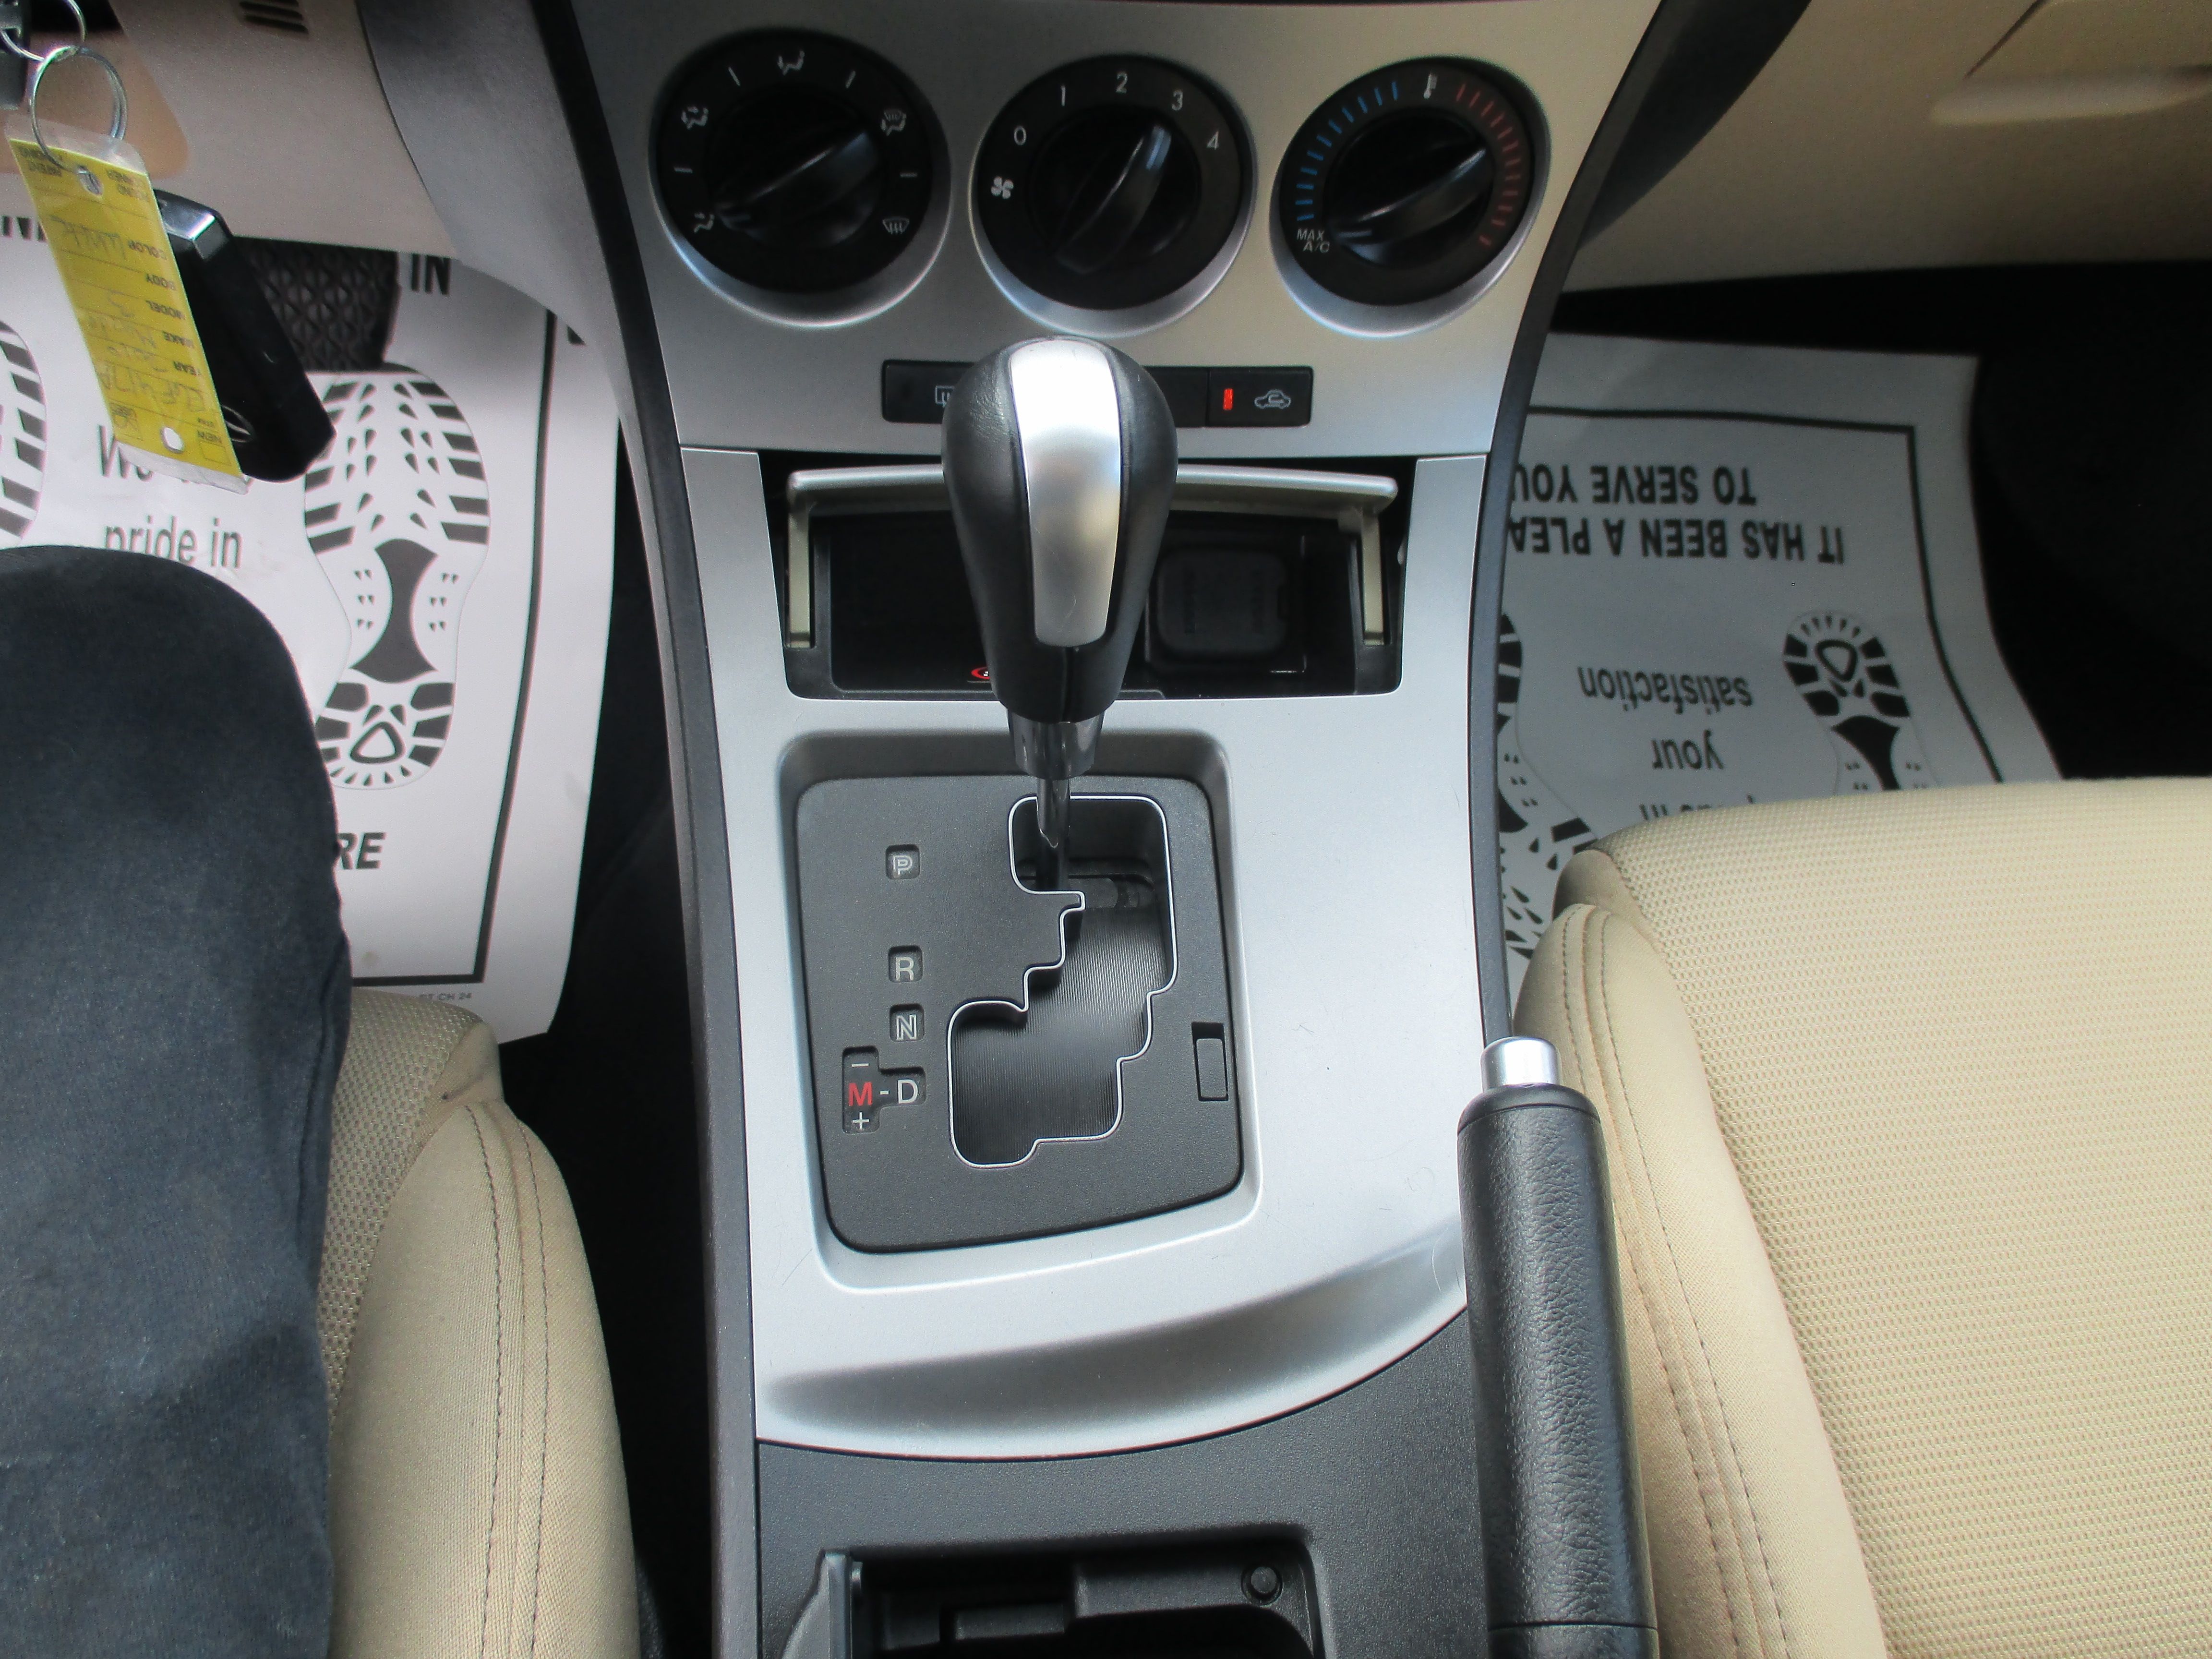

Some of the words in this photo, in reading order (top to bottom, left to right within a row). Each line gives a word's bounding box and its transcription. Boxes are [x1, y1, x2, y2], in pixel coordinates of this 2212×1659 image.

[1116, 72, 1128, 93] 2
[1060, 85, 1066, 106] 1
[1172, 89, 1183, 110] 3
[1014, 126, 1027, 145] 0
[1207, 131, 1219, 150] 4
[1297, 229, 1325, 240] MAX
[1302, 241, 1330, 252] A/C
[145, 273, 177, 290] BODY
[145, 301, 186, 320] MODEL
[162, 331, 194, 348] MAKE
[173, 361, 201, 376] YEAR
[1590, 465, 1699, 504] SERVE
[1714, 466, 1756, 505] TO
[211, 517, 243, 568] in
[1508, 517, 1590, 554] PLEA
[1604, 518, 1624, 556] A
[1640, 518, 1728, 558] BEEN
[1741, 520, 1805, 561] HAS
[1818, 526, 1845, 564] IT
[1577, 666, 1753, 714] satisfaction
[1652, 729, 1725, 769] your
[893, 855, 913, 875] P
[895, 957, 914, 981] R
[896, 1014, 917, 1041] N
